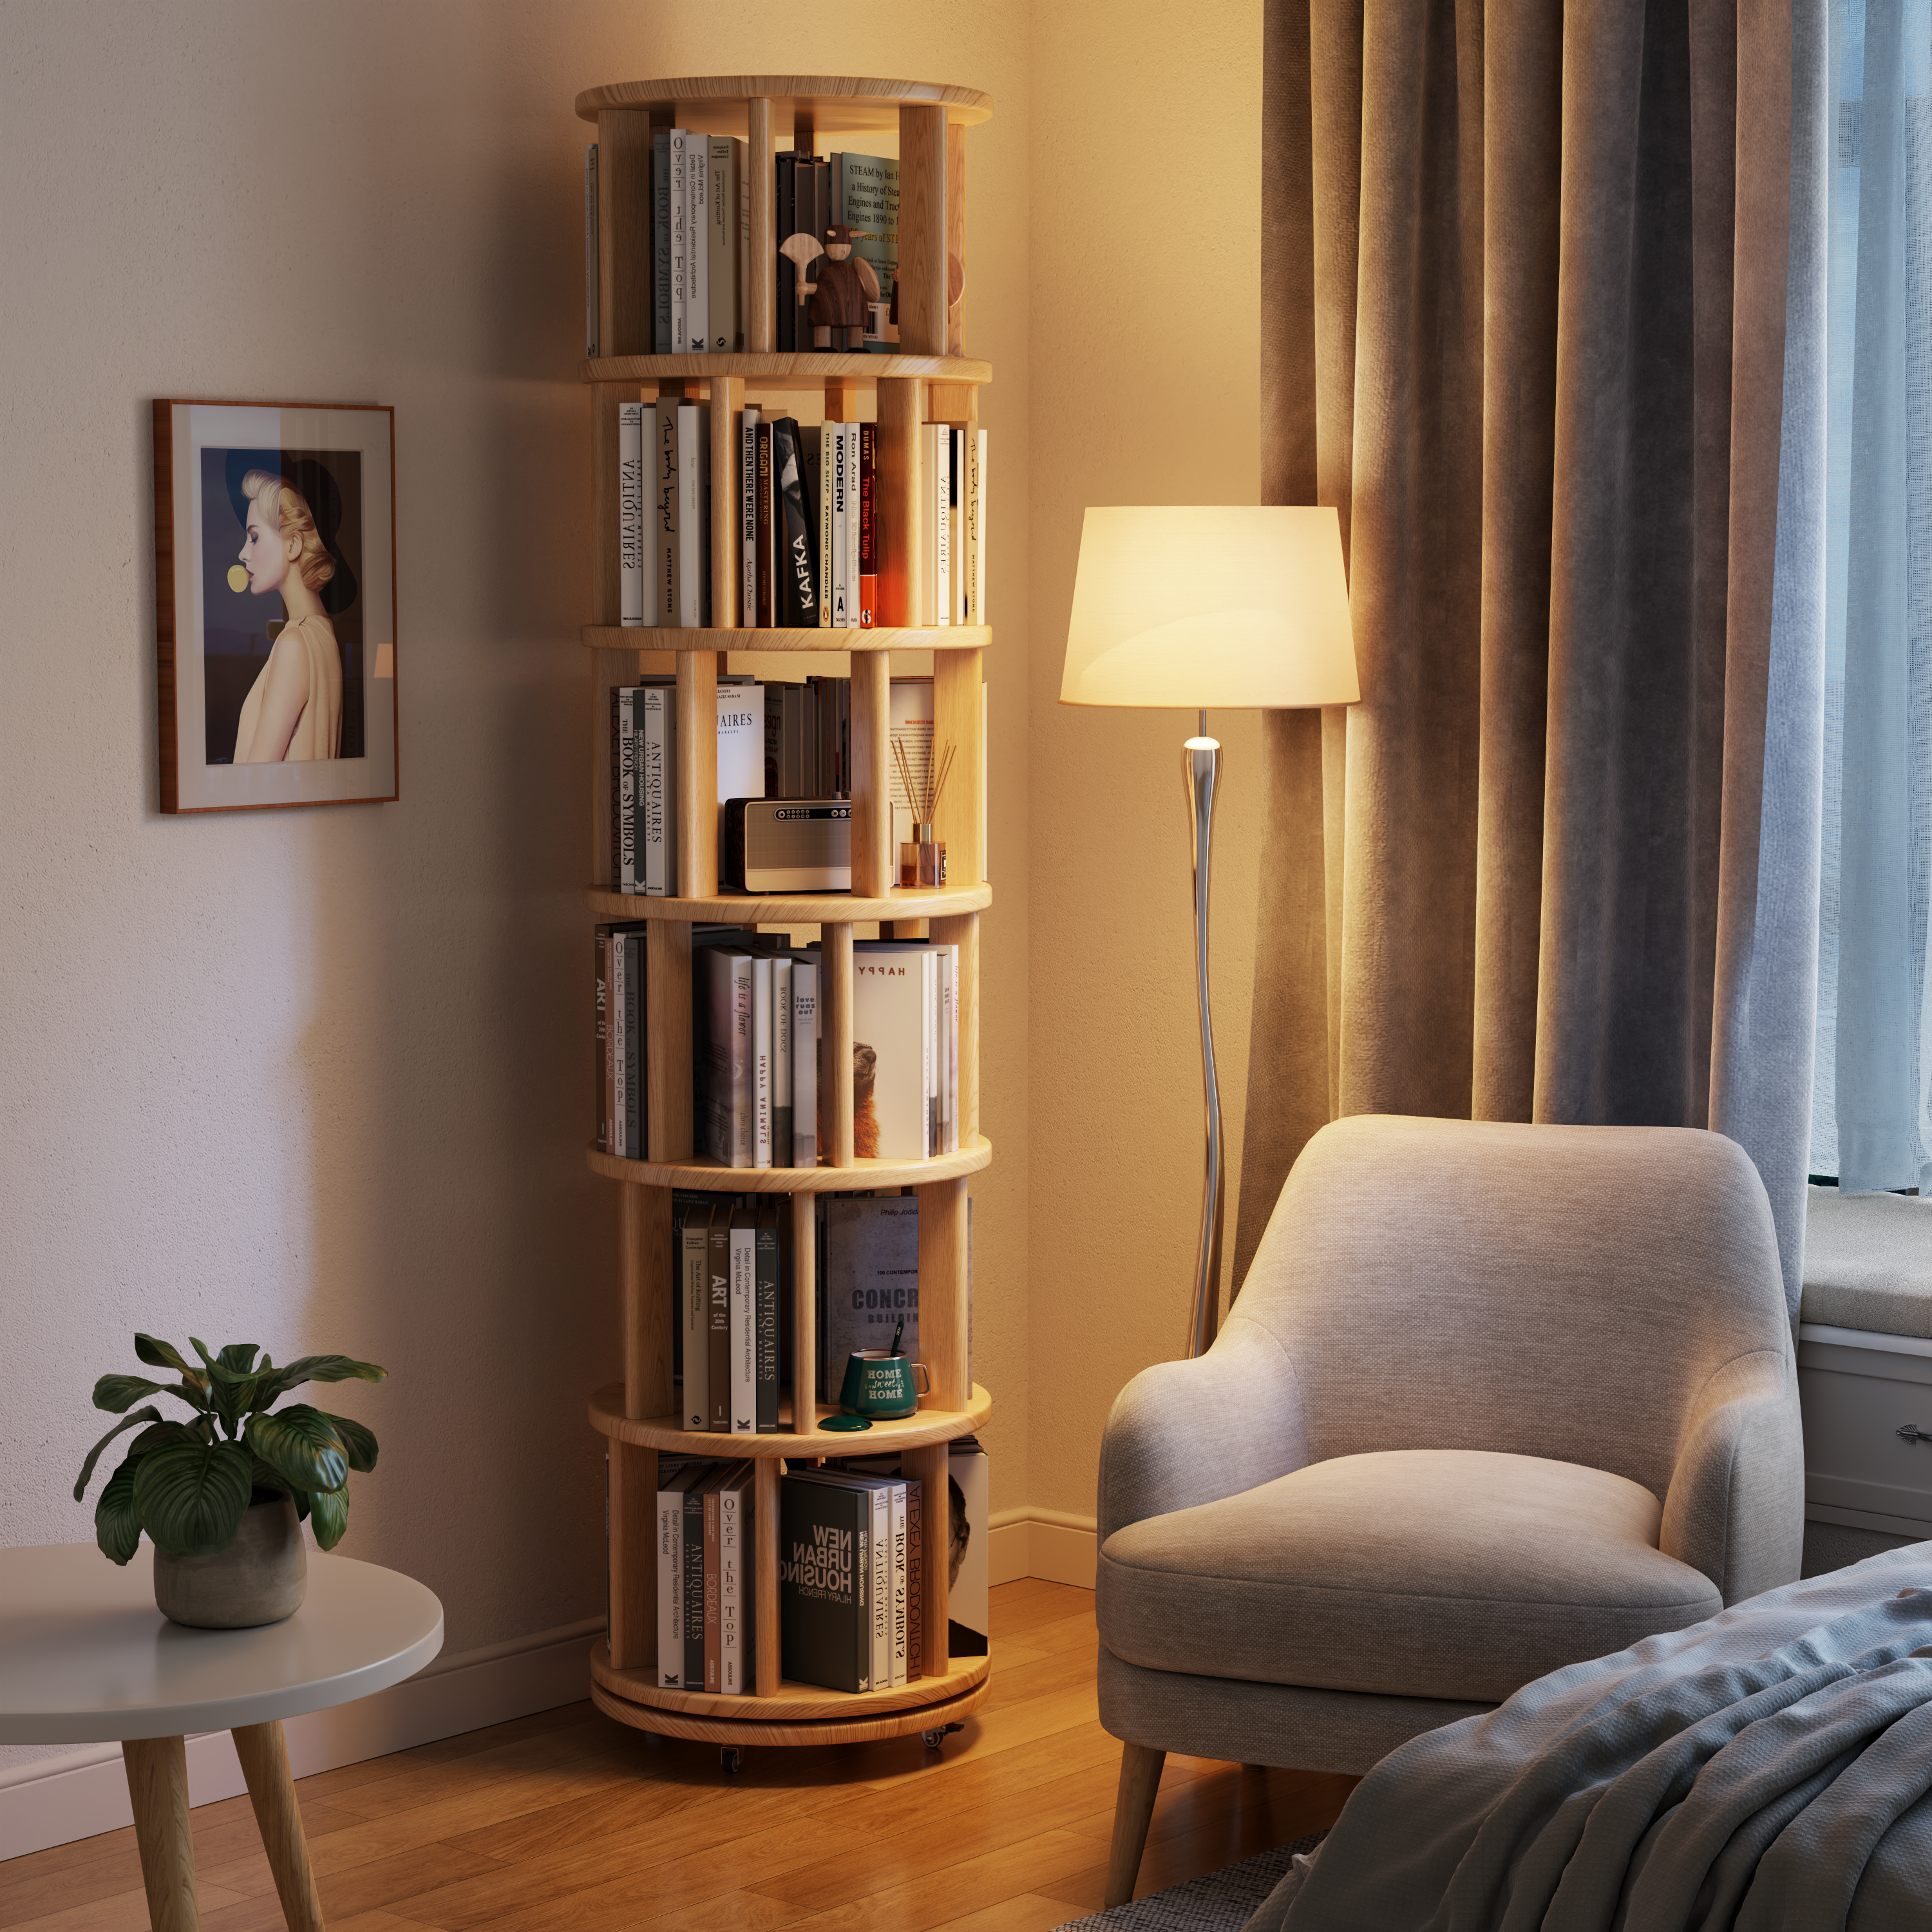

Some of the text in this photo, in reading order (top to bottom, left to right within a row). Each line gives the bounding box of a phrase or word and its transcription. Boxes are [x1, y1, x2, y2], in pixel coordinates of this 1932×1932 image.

[850, 164, 875, 177] STEAM
[876, 167, 884, 180] by
[885, 169, 894, 180] Ian
[848, 196, 872, 209] Engines
[873, 200, 884, 209] and
[857, 182, 878, 196] History
[880, 185, 887, 195] of
[848, 211, 894, 225] Engines 1890 to
[878, 232, 886, 242] of
[759, 437, 768, 477] ORIGAMI
[658, 416, 677, 532] The body beyond
[745, 427, 754, 542] AND THEN THERE WERE NONE
[851, 500, 857, 518] No
[862, 533, 870, 560] Tulip
[793, 534, 814, 609] KAFKA
[837, 596, 844, 612] A
[622, 737, 634, 778] BOOK
[623, 781, 628, 790] OF
[650, 742, 661, 842] ANTIQUAIRES
[623, 793, 634, 866] SYMBOLS
[734, 977, 750, 990] life
[734, 1009, 750, 1036] flower
[740, 1113, 748, 1146] chris choice
[880, 1209, 898, 1217] Philip
[712, 1274, 727, 1308] ART
[743, 1273, 752, 1314] Contemporary
[852, 1288, 918, 1310] CONCR
[762, 1280, 775, 1381] ANTIQUAIRES
[867, 1368, 902, 1379] HOME
[874, 1378, 896, 1389] sweet
[868, 1388, 903, 1399] HOME
[724, 1499, 735, 1545] Over
[690, 1544, 703, 1640] ANTIQUAIRES
[706, 1573, 717, 1624] BORDEAUX
[725, 1606, 735, 1645] Top
